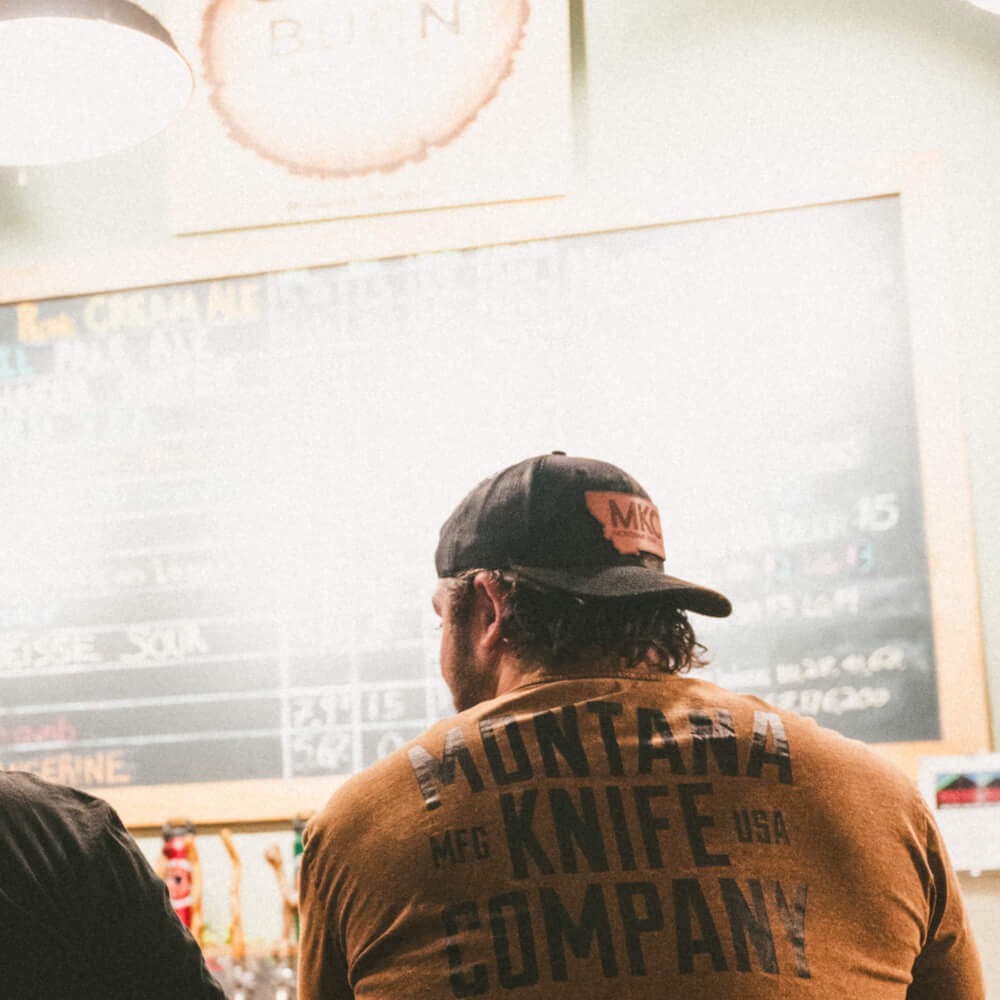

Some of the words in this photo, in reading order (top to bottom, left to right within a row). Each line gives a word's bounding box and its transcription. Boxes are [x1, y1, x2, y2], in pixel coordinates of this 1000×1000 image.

[407, 700, 794, 811] MONTANA
[429, 825, 490, 868] MFG
[500, 781, 732, 880] KNIFE
[733, 808, 790, 846] USA
[440, 876, 812, 999] COMPANY
